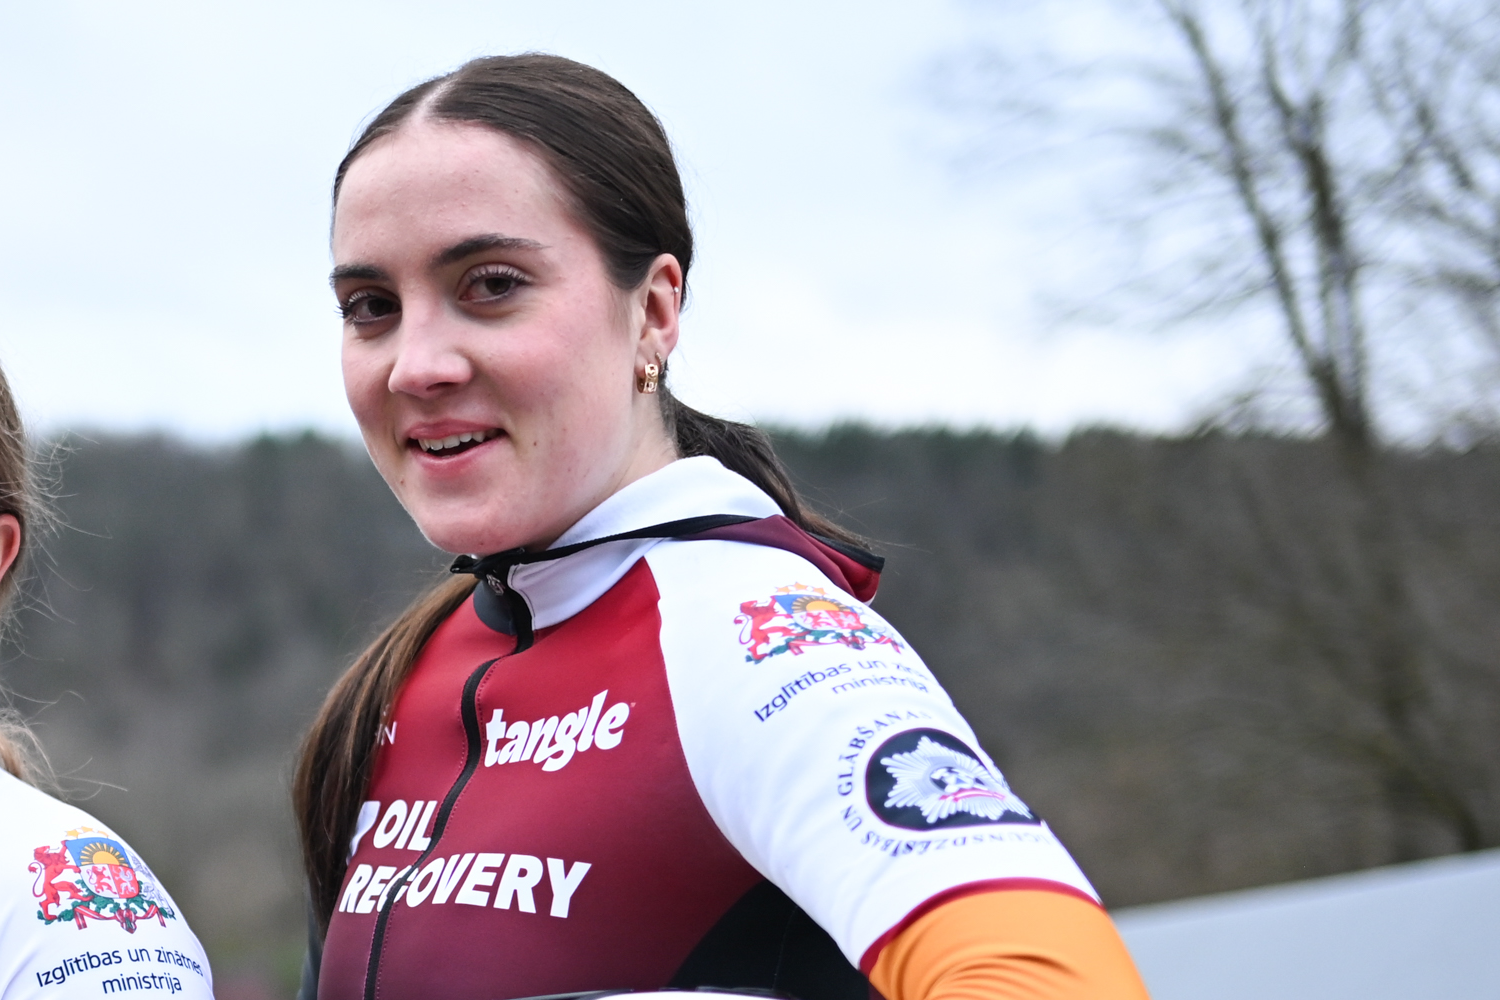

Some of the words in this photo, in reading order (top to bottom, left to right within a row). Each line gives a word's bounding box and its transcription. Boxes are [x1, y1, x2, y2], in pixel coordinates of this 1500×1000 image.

[754, 661, 852, 723] Izglītības
[857, 658, 888, 670] un
[484, 689, 630, 772] tangle
[373, 799, 438, 851] OIL
[338, 852, 593, 919] RECOVERY
[36, 950, 123, 988] Izglītības
[127, 947, 151, 963] un
[102, 972, 183, 995] ministrija
